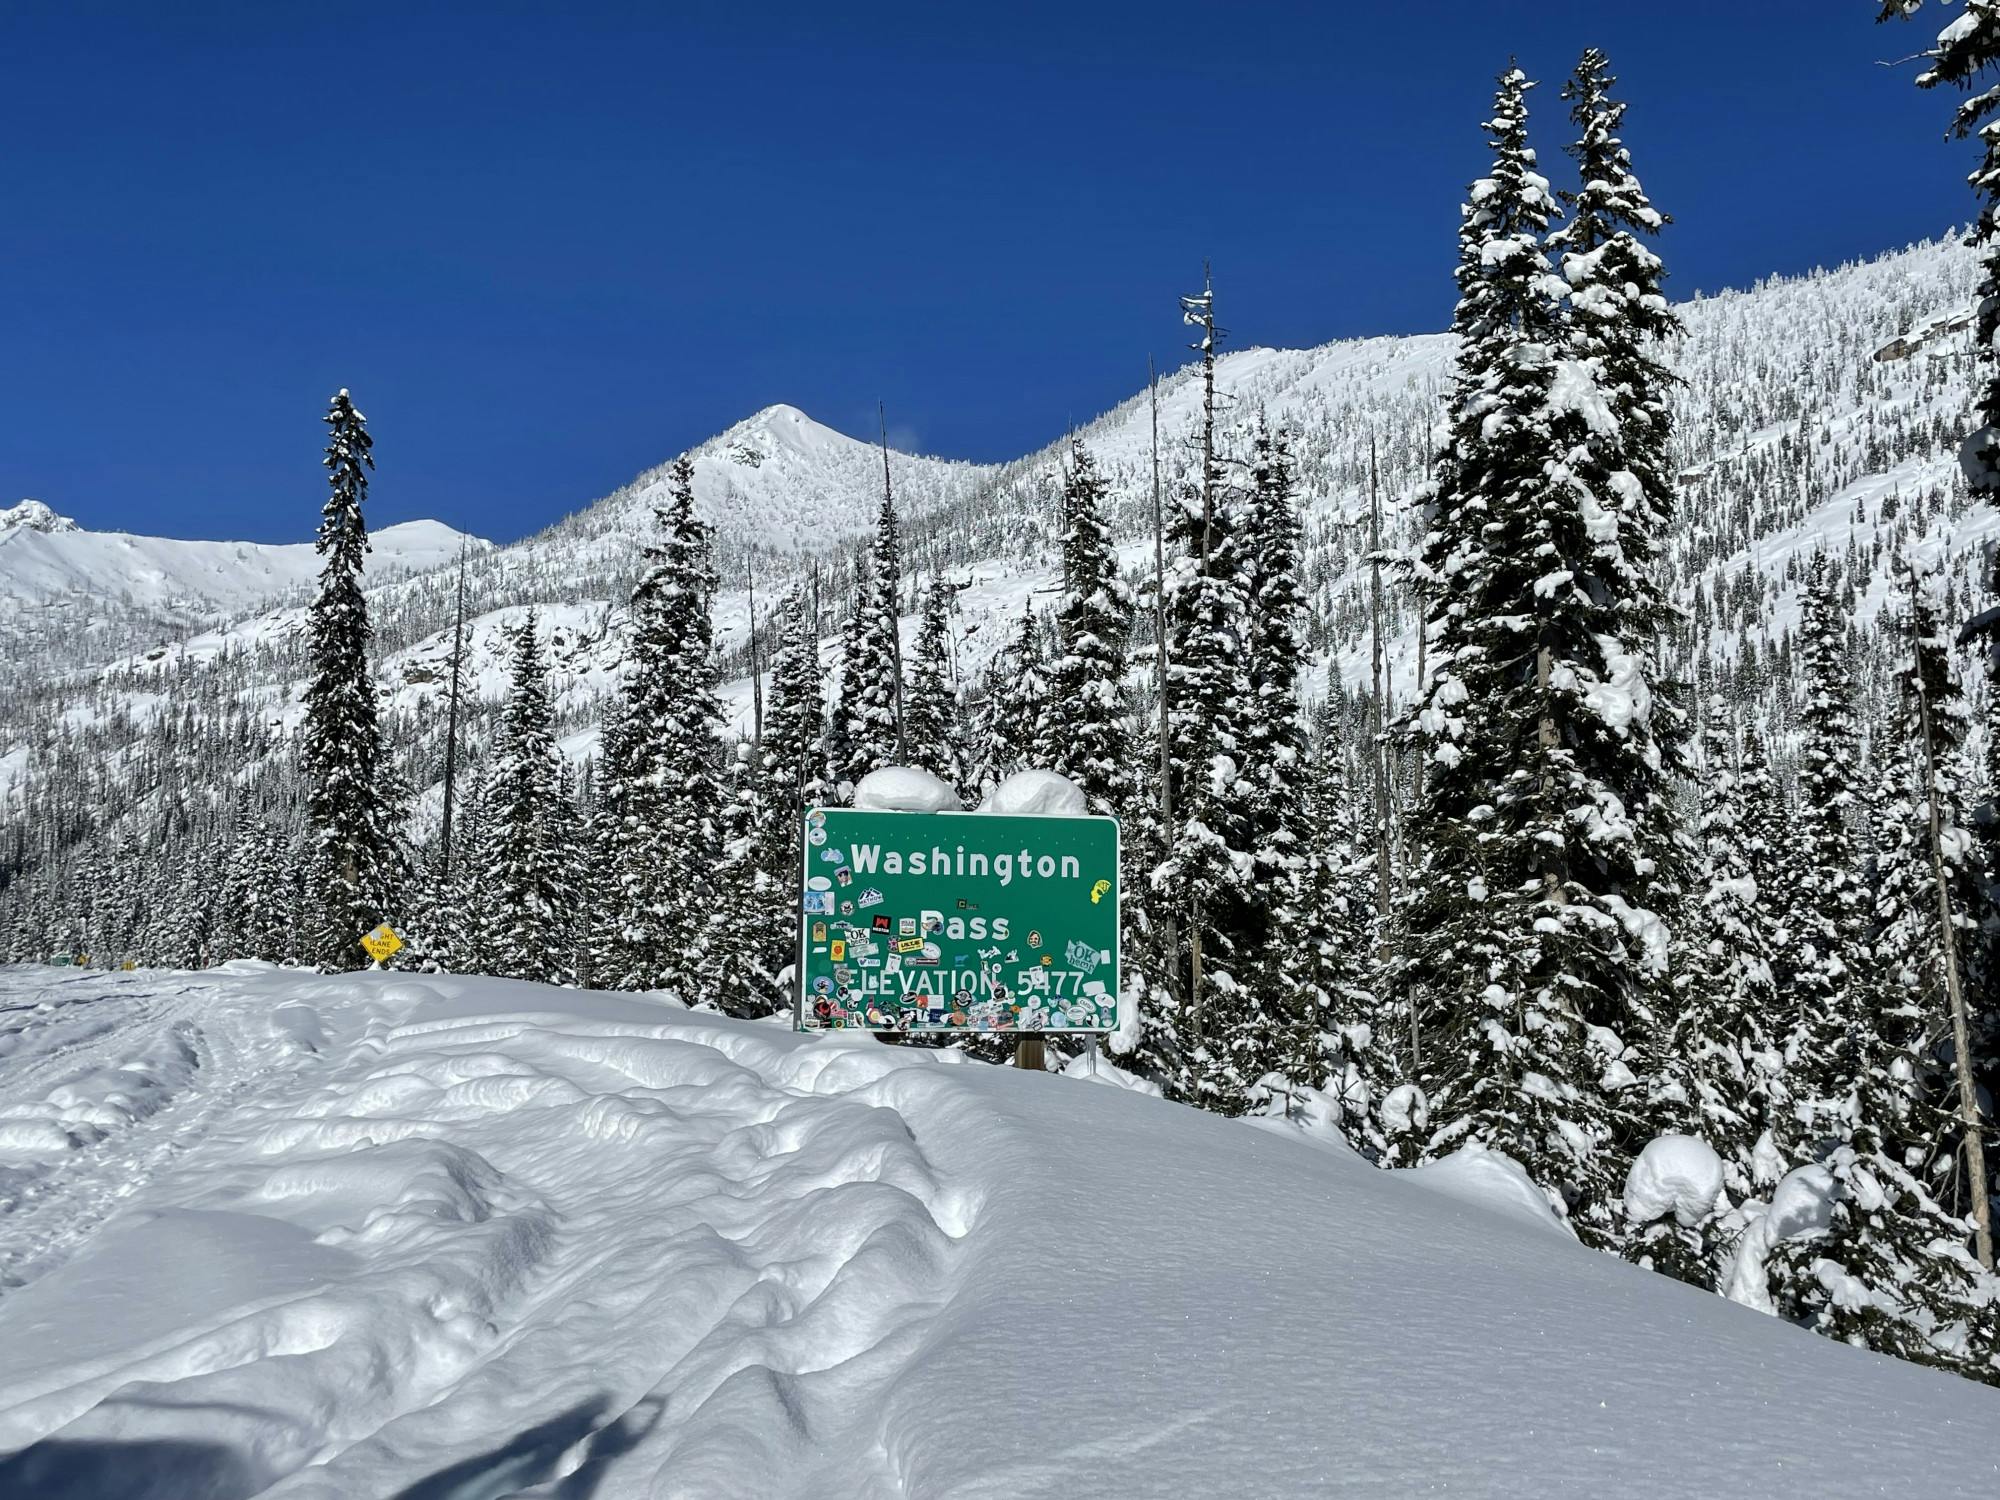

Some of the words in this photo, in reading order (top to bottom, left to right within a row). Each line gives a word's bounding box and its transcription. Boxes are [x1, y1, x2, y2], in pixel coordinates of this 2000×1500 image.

[851, 844, 1080, 886] Washington
[850, 929, 867, 940] OK
[920, 910, 1009, 941] Pass
[1069, 954, 1095, 973] hemp
[1074, 945, 1096, 963] OK
[1017, 970, 1085, 996] 5477
